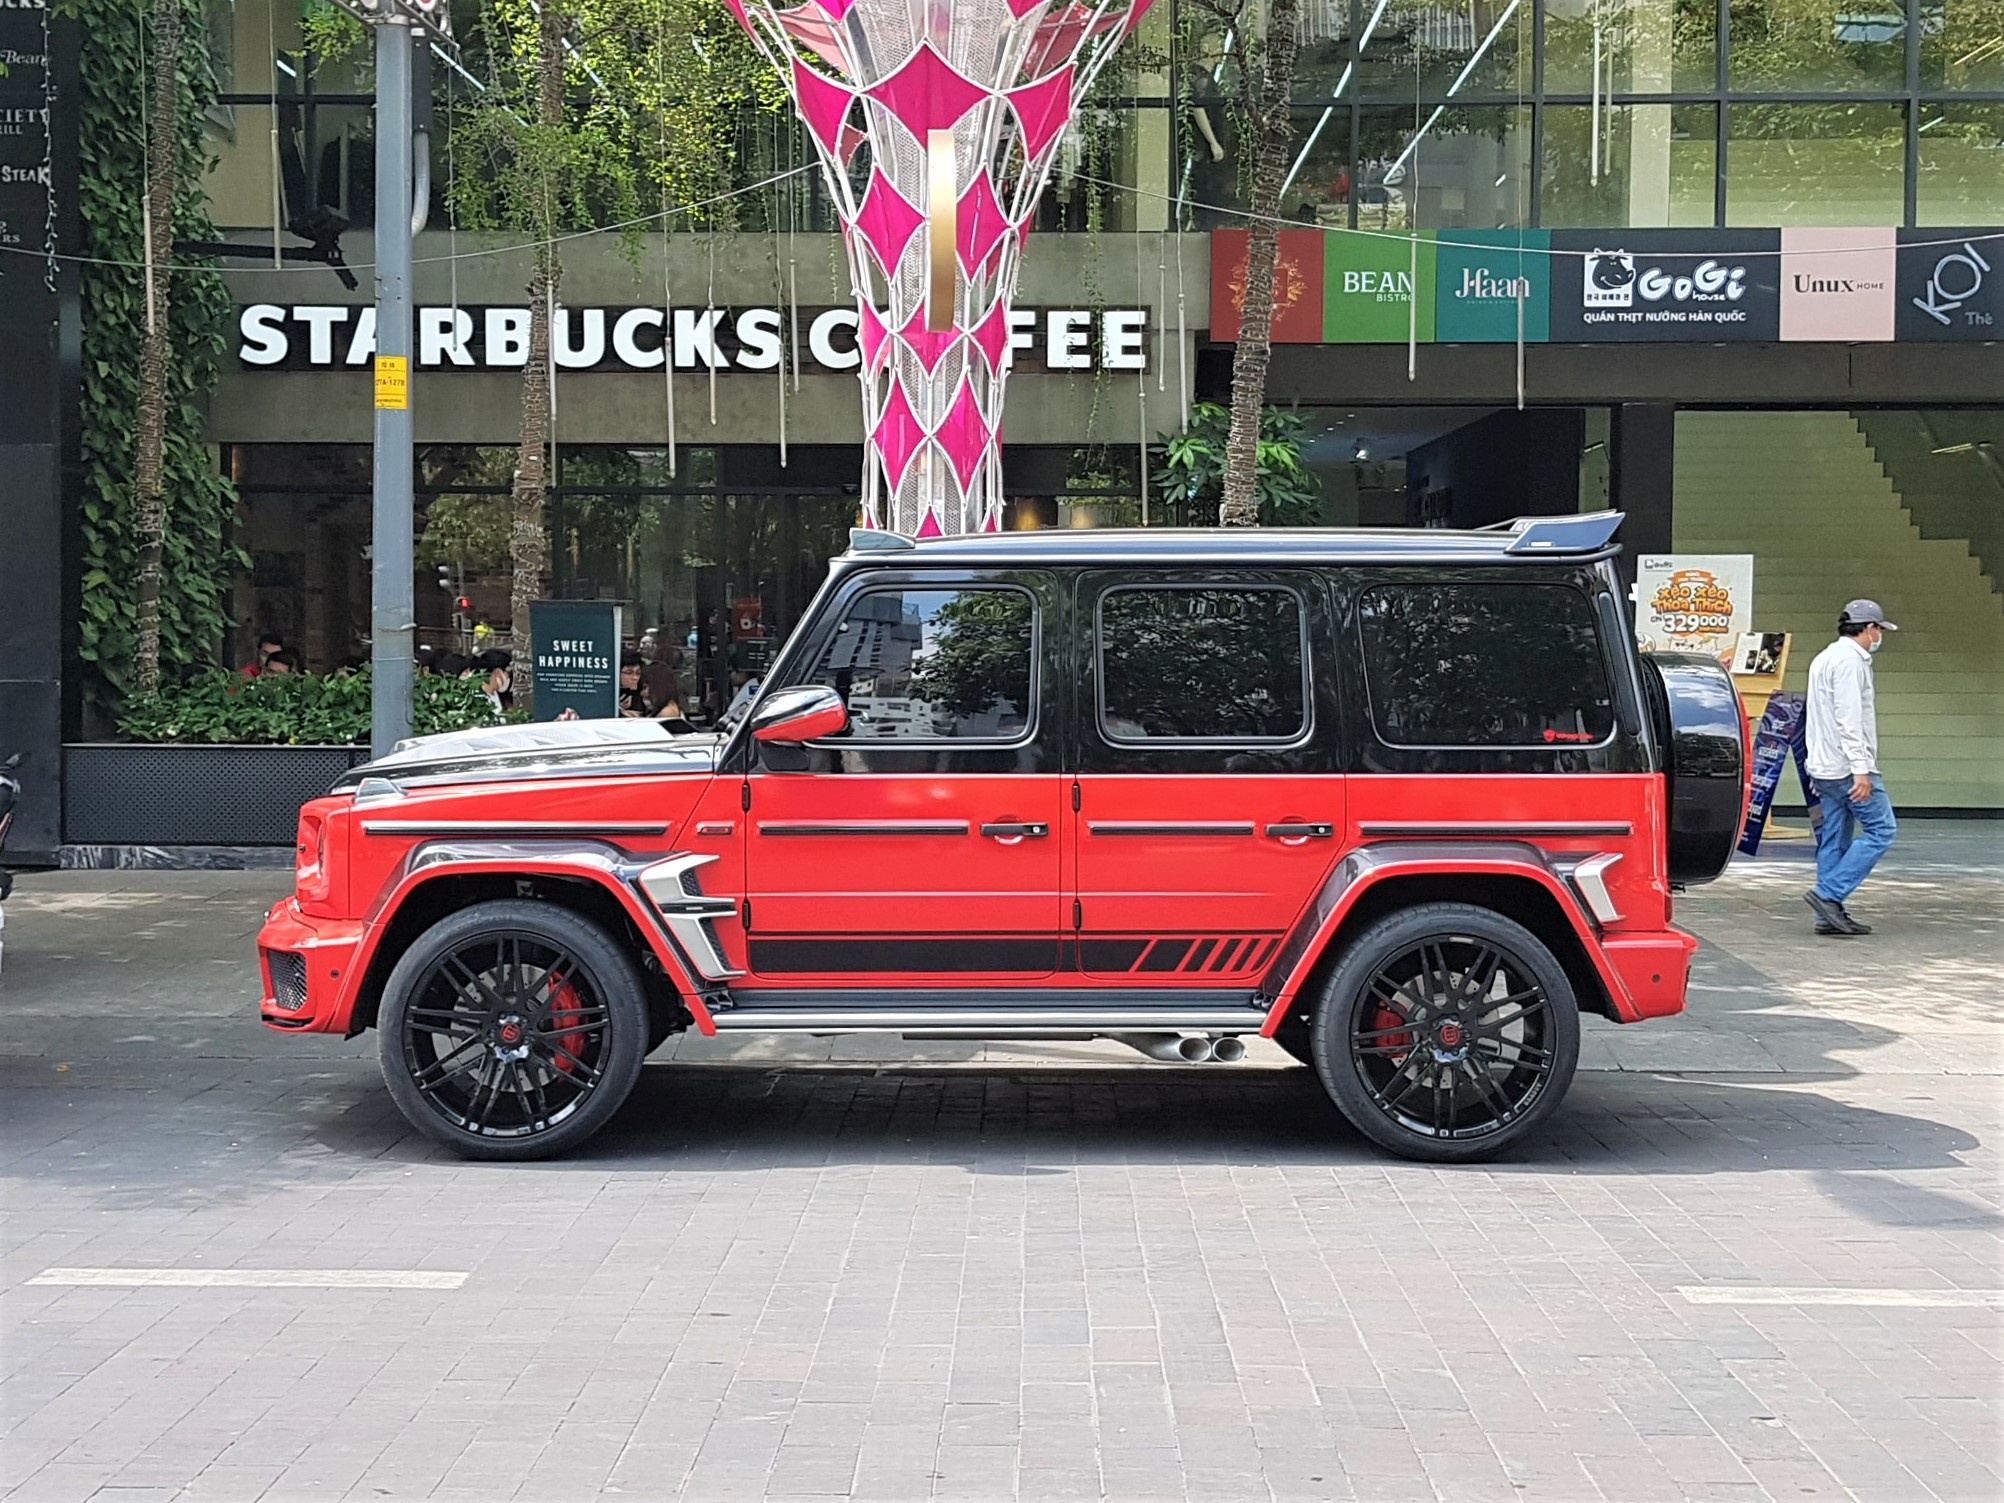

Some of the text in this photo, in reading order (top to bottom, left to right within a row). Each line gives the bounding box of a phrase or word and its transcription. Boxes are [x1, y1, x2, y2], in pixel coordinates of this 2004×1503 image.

[1794, 274, 1885, 293] Unux HOME
[809, 308, 1147, 369] CFEE
[553, 640, 594, 653] SWEET
[538, 655, 609, 669] HAPPINESS
